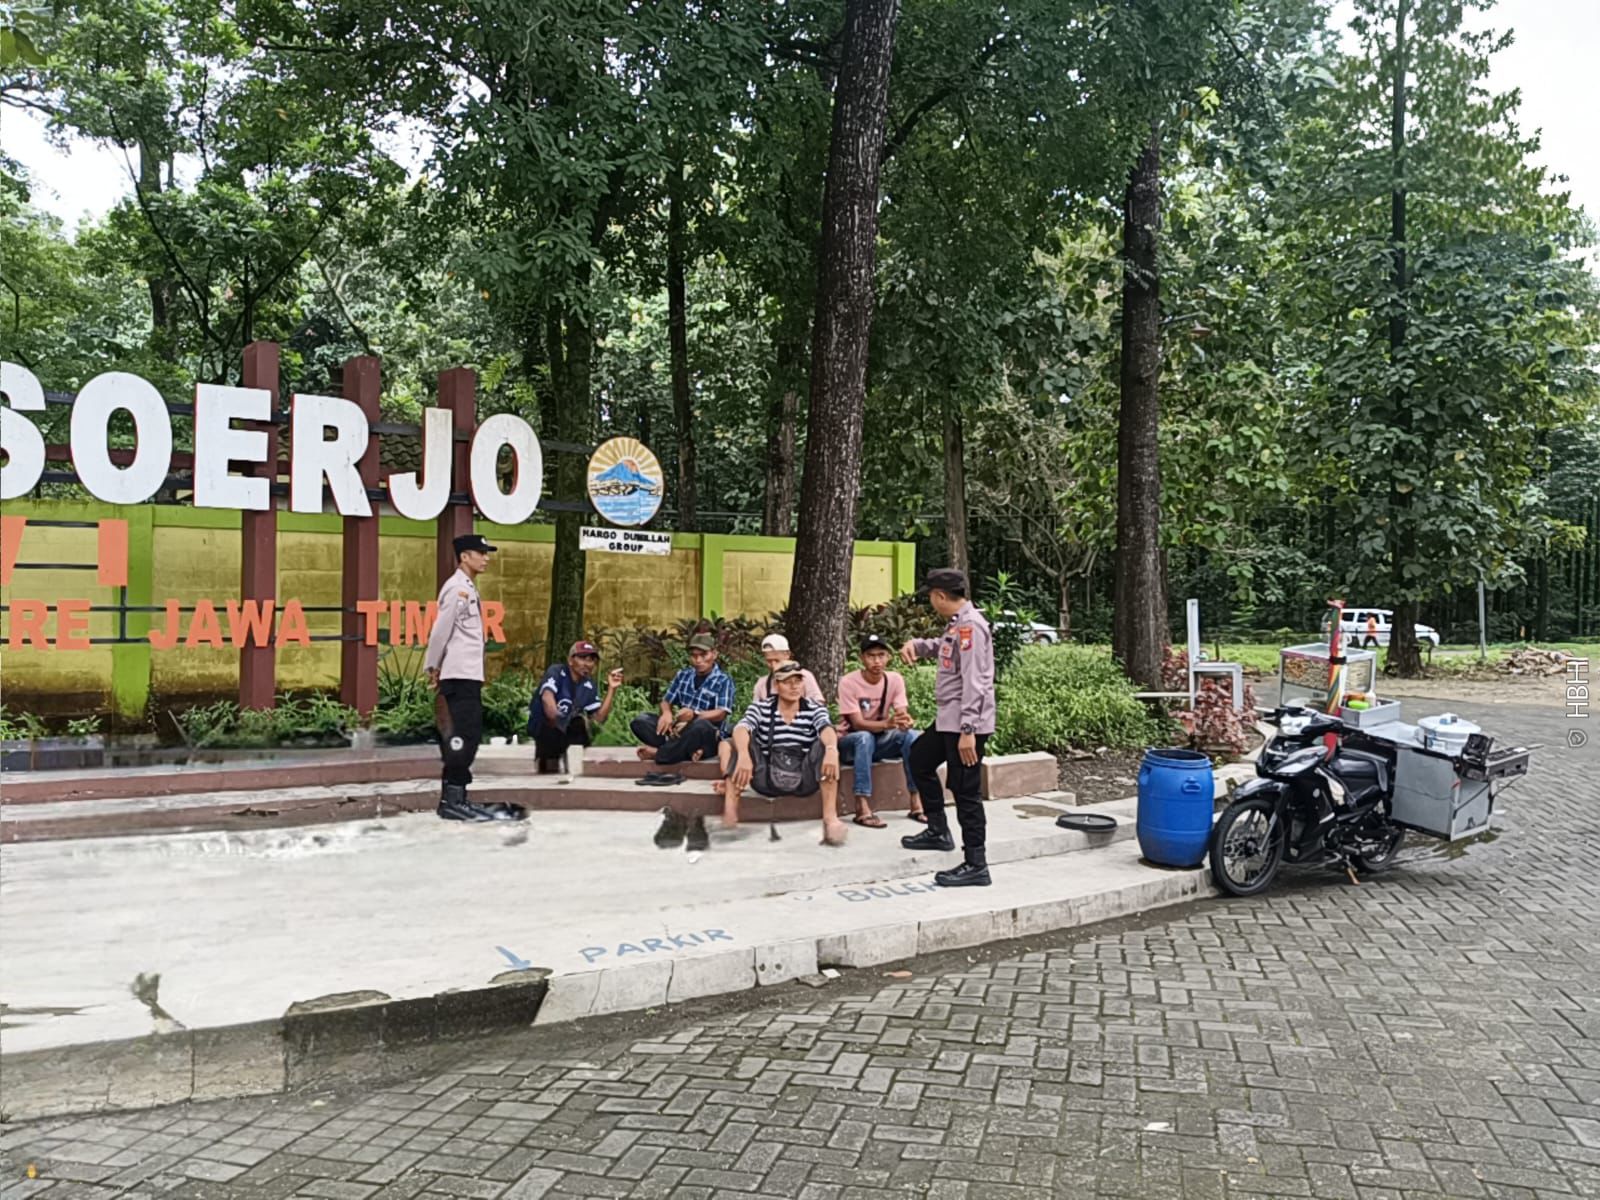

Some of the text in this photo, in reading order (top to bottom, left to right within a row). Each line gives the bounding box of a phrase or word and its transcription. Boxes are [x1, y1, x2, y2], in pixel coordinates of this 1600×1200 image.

[608, 542, 644, 552] GROUP
[148, 599, 311, 650] JAWA
[356, 600, 507, 647] TIMR
[578, 929, 734, 963] PARKIR
